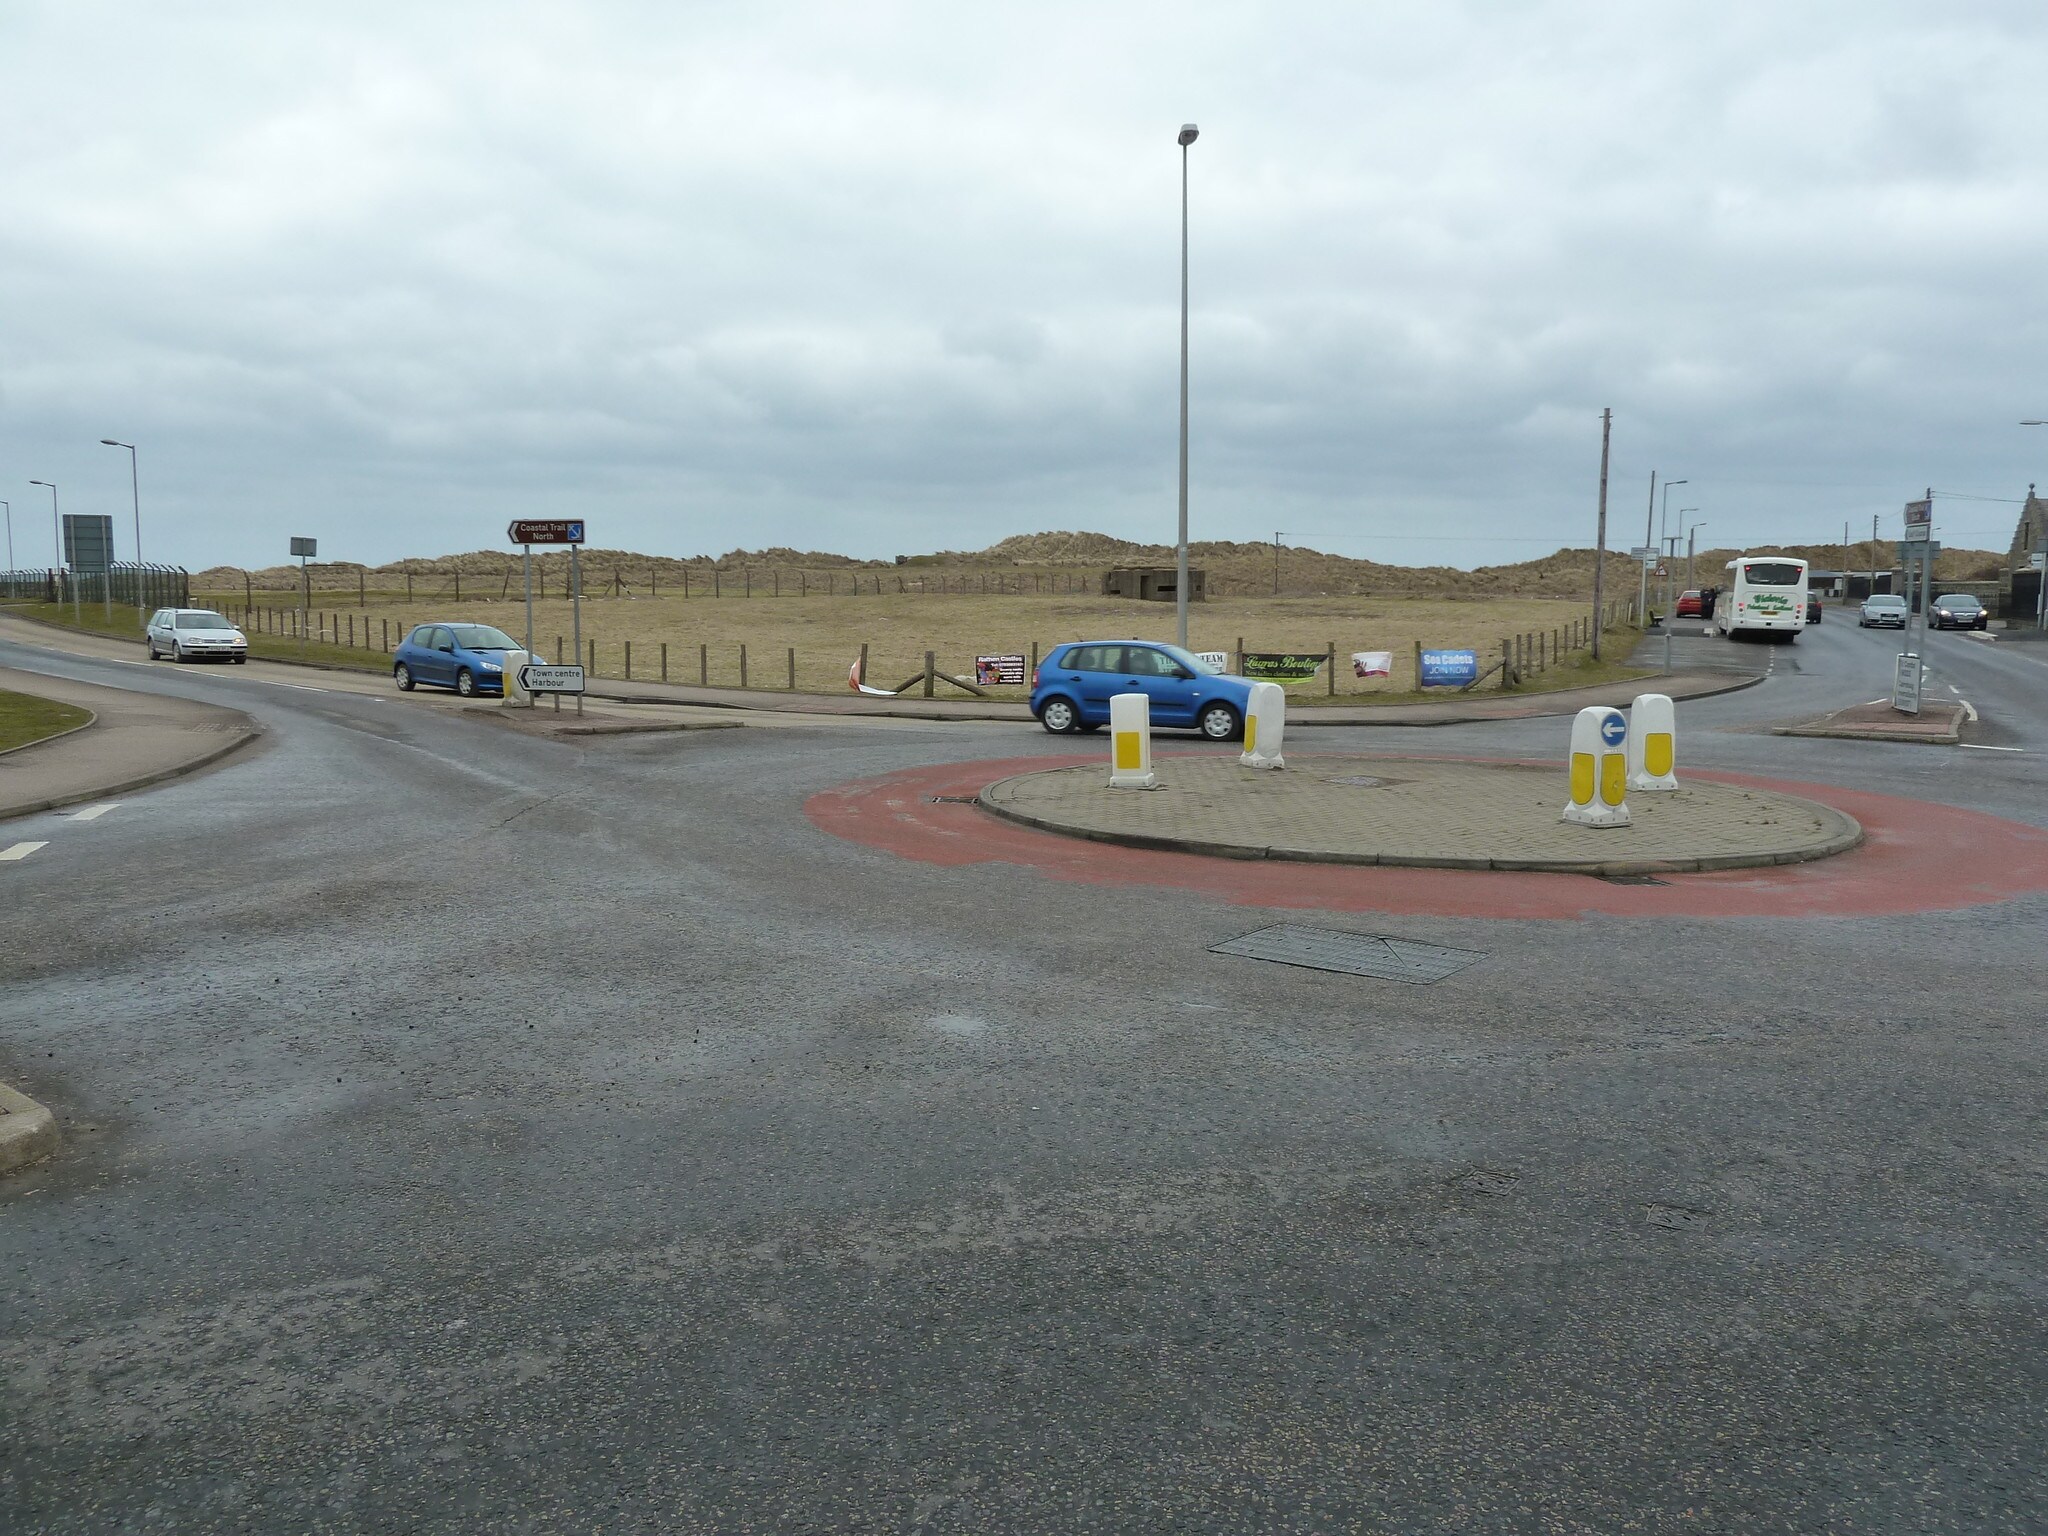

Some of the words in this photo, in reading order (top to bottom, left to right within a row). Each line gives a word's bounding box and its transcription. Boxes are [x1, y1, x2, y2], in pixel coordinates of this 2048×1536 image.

[520, 523, 549, 532] Coastal
[550, 523, 566, 531] Trail
[532, 532, 554, 540] North
[1200, 654, 1223, 663] TEAM
[1423, 654, 1441, 665] Sea
[1441, 654, 1473, 665] Cadets
[532, 669, 553, 677] Town
[554, 669, 580, 677] centre
[1429, 666, 1448, 675] JOIN
[1449, 666, 1470, 674] NOW
[532, 678, 565, 687] Harbour
